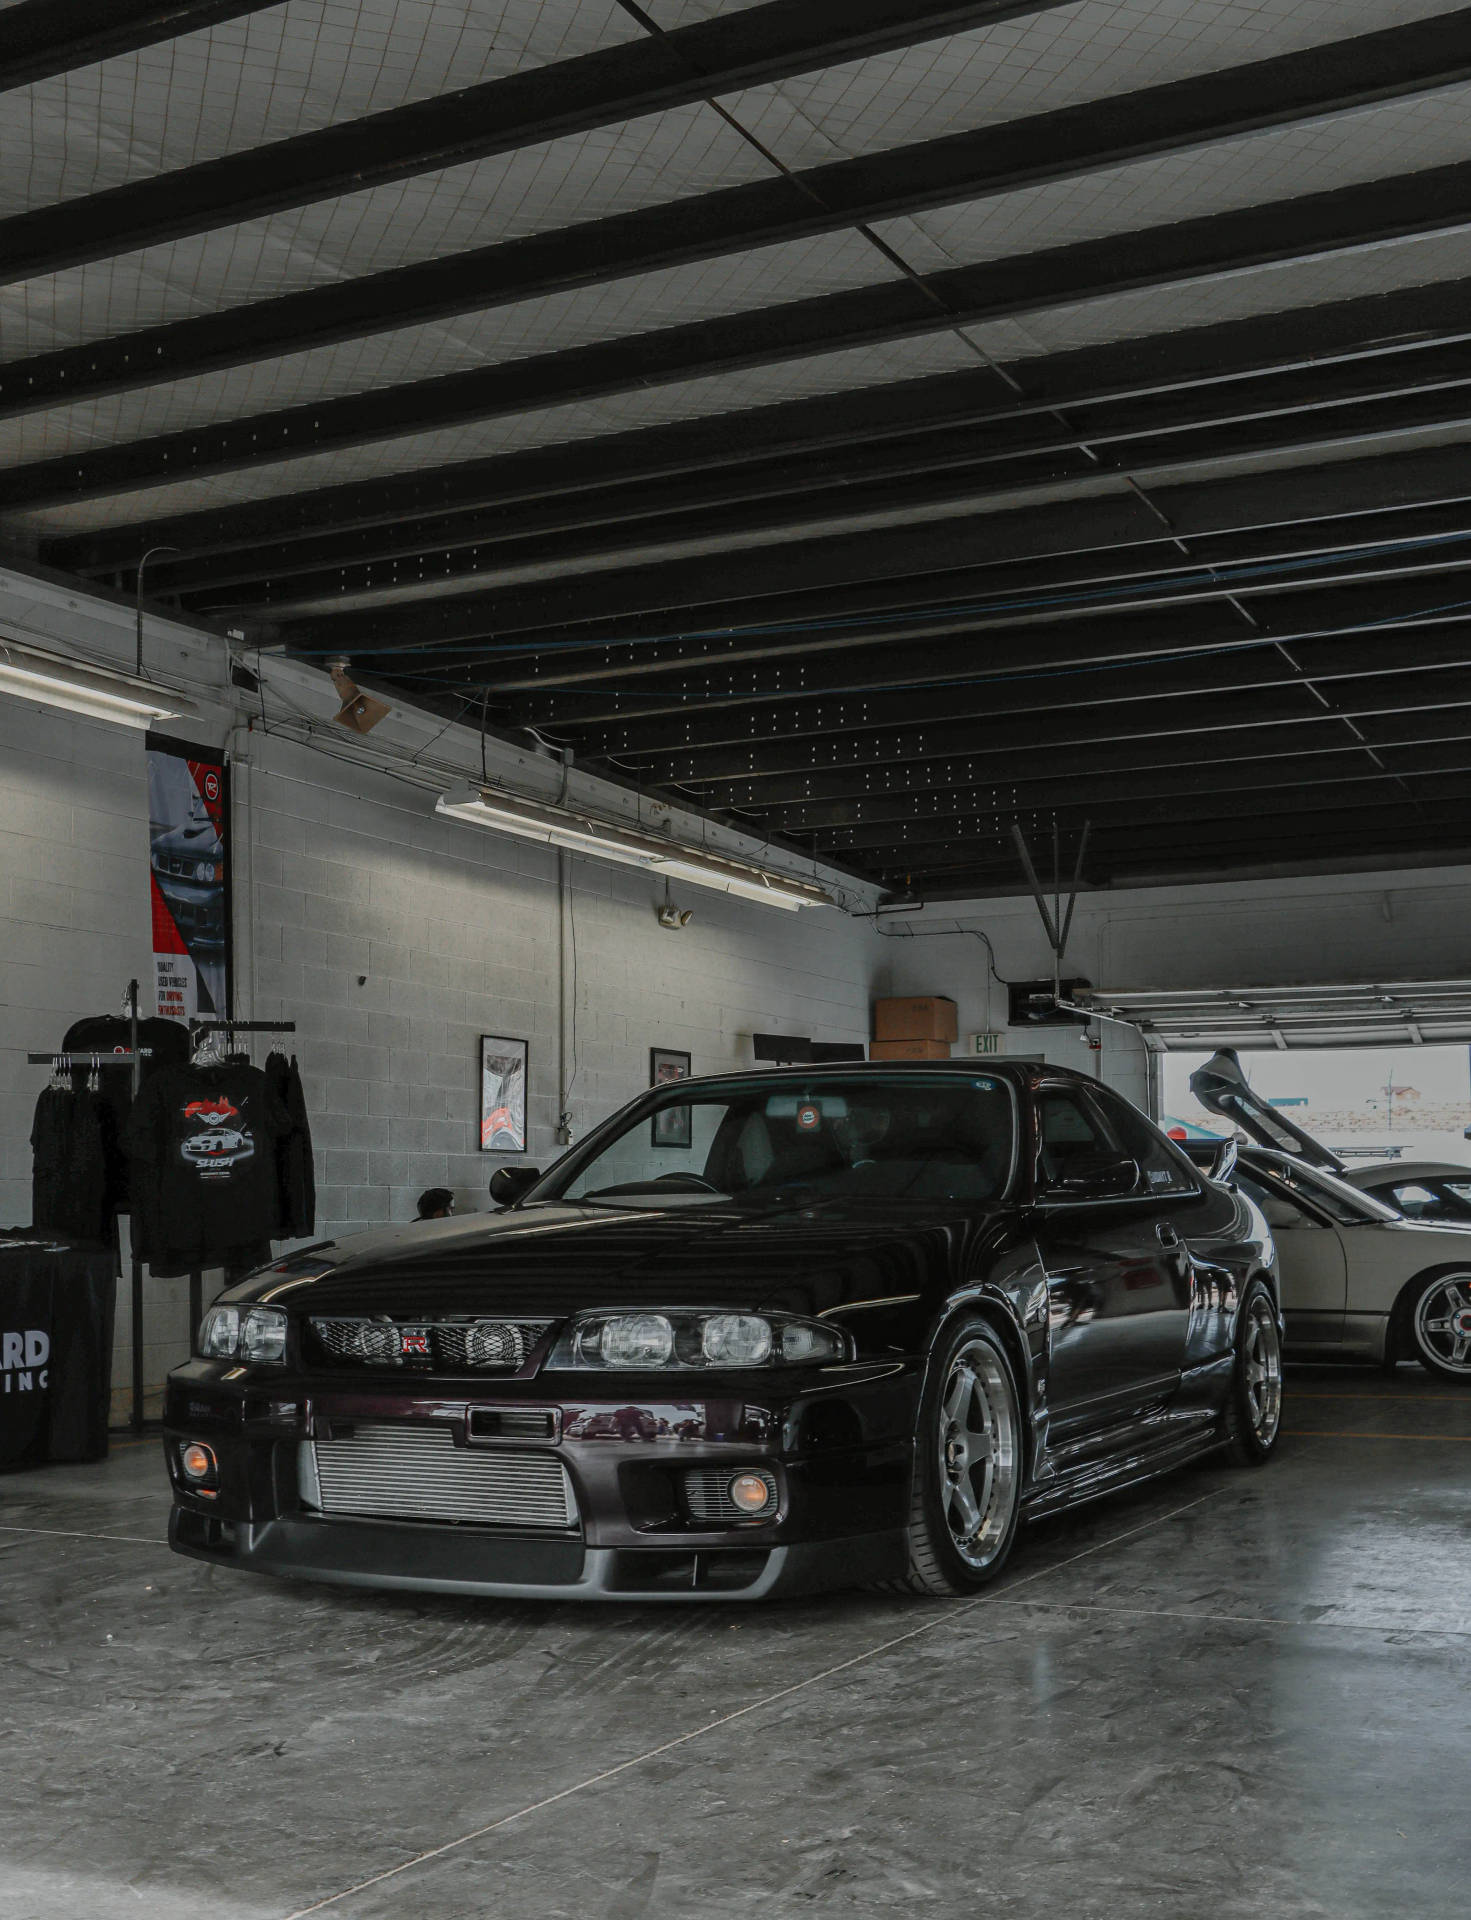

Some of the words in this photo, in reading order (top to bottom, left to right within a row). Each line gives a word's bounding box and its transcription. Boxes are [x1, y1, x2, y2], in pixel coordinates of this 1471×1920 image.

[158, 976, 168, 986] USED
[169, 976, 187, 988] VEHICLES
[166, 991, 183, 1002] DRIVING
[976, 1034, 998, 1053] EXIT
[0, 1330, 51, 1371] RD
[5, 1370, 49, 1393] INC
